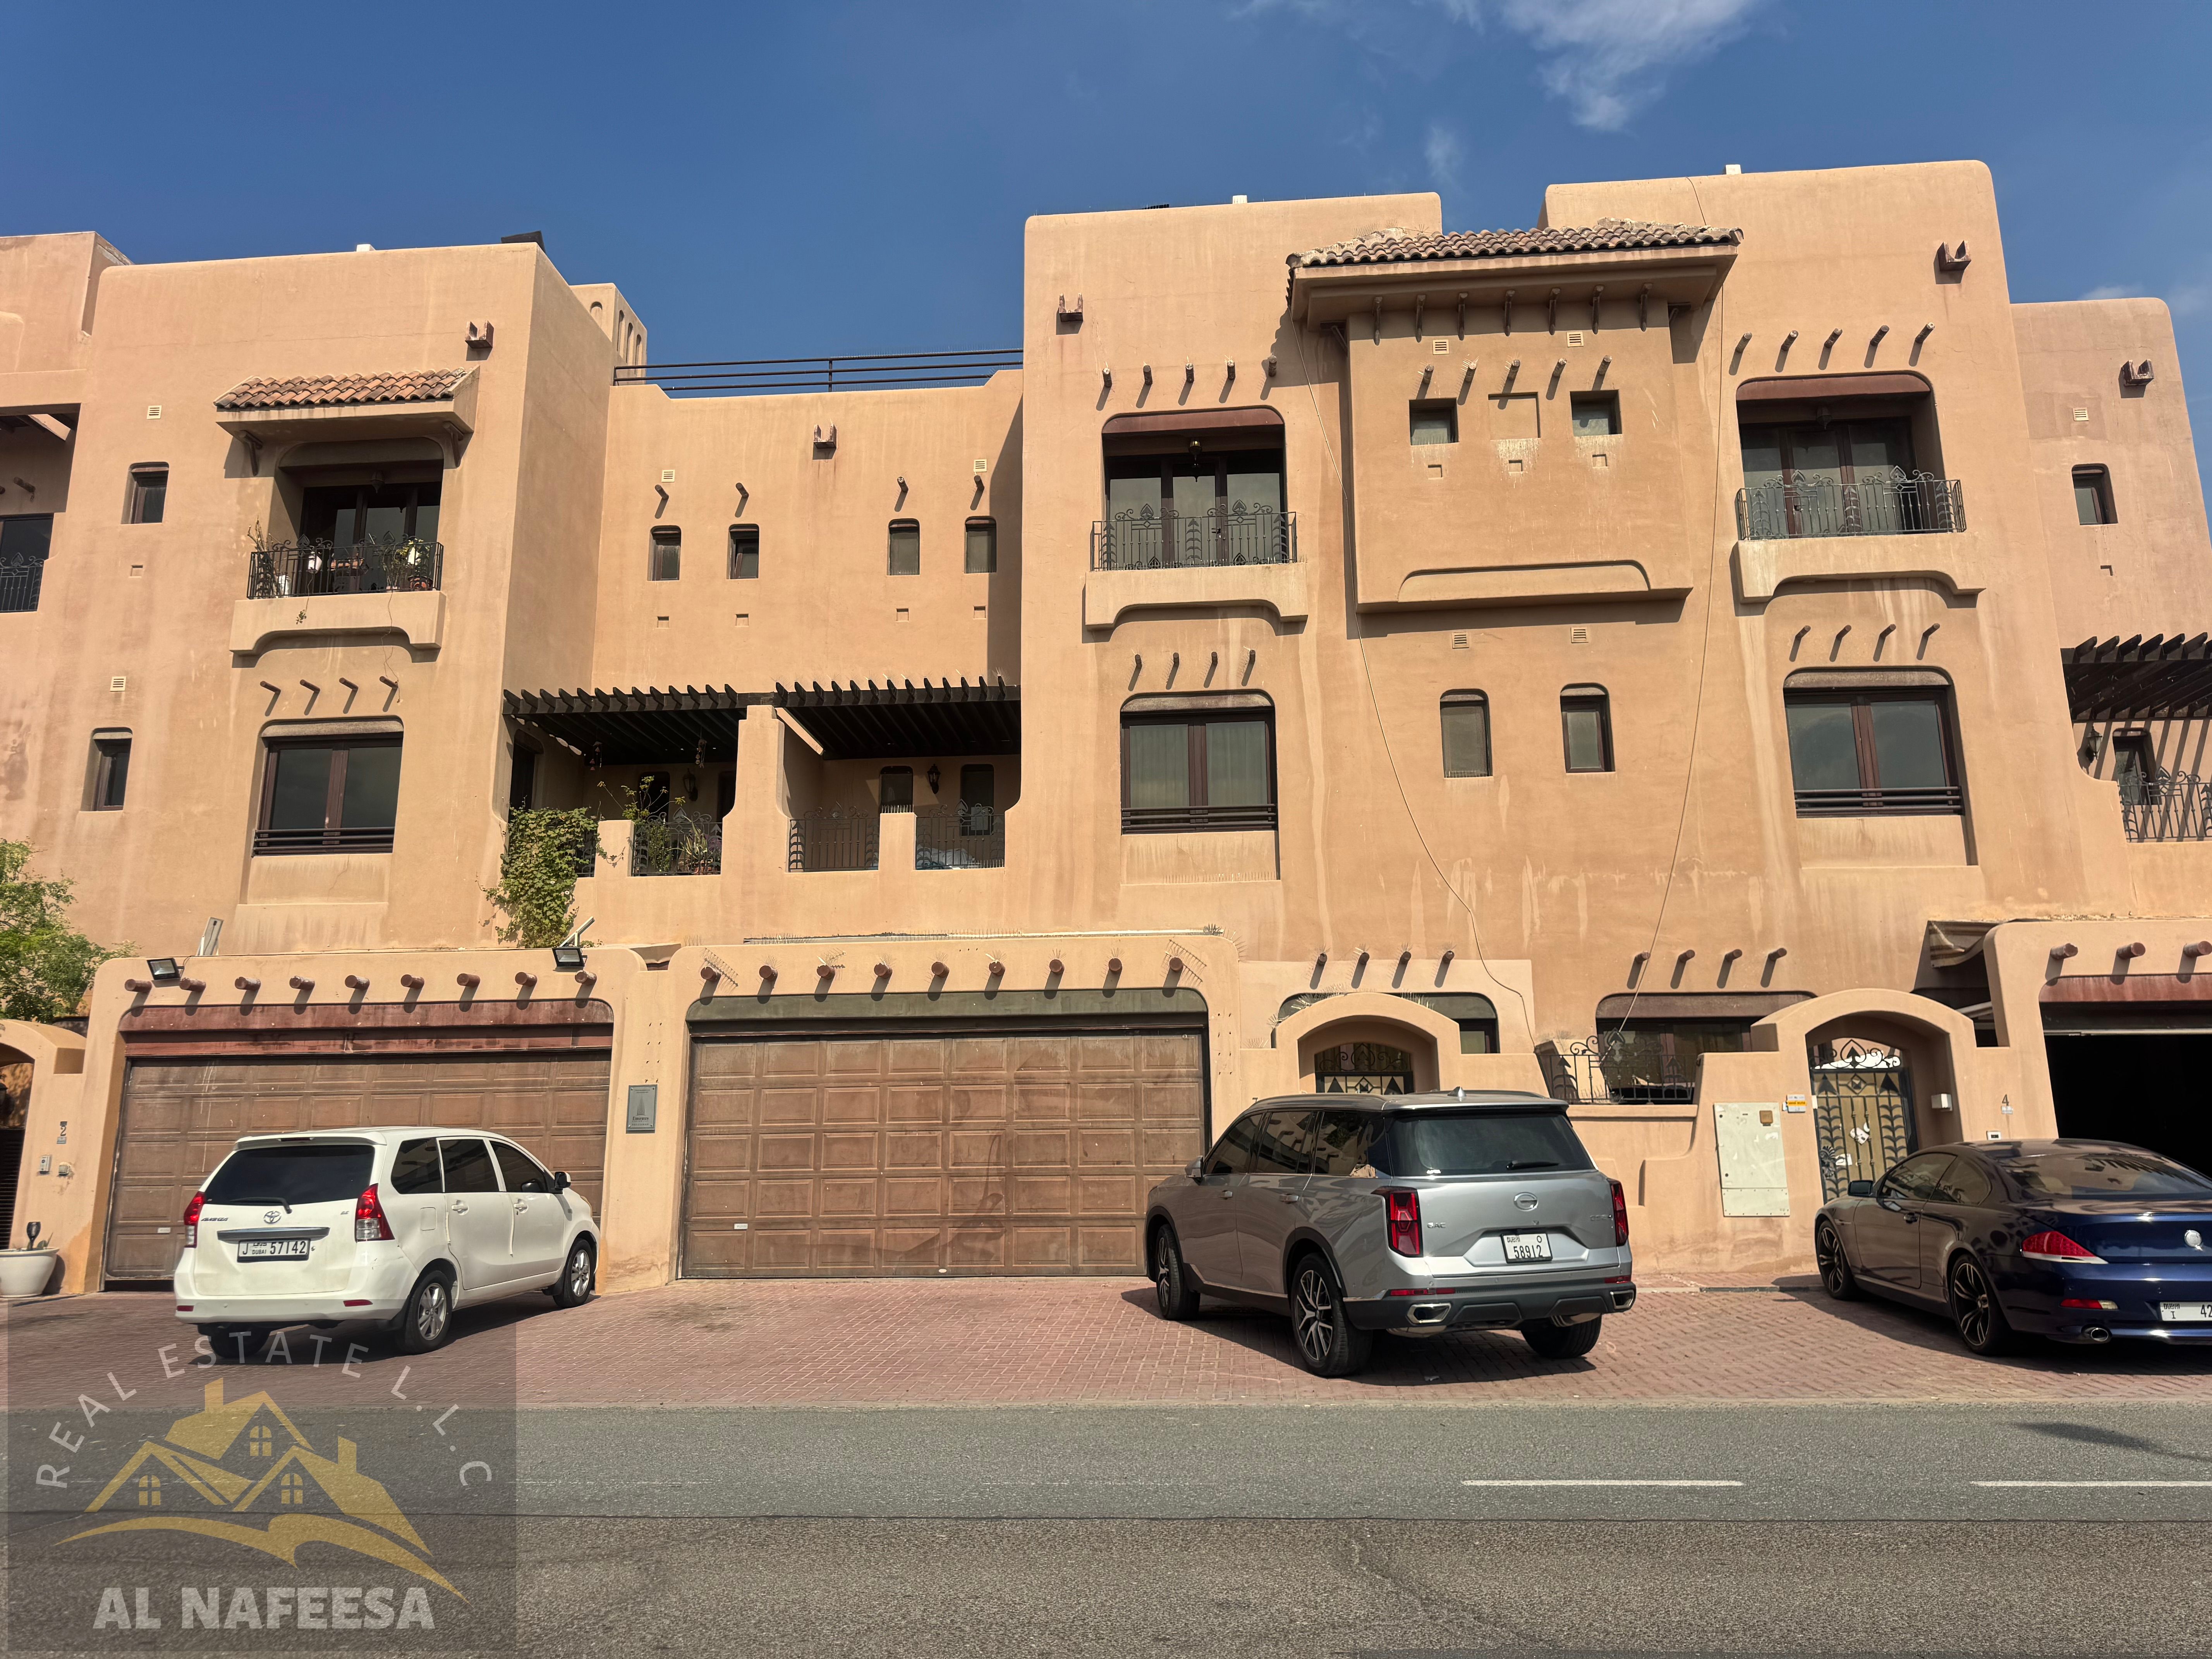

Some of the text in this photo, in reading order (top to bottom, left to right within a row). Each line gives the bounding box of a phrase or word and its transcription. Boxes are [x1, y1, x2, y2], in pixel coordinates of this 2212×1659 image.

[2002, 1094, 2009, 1106] 4
[60, 1125, 67, 1137] 2
[242, 1240, 306, 1255] J 57142
[1513, 1245, 1543, 1259] 58912
